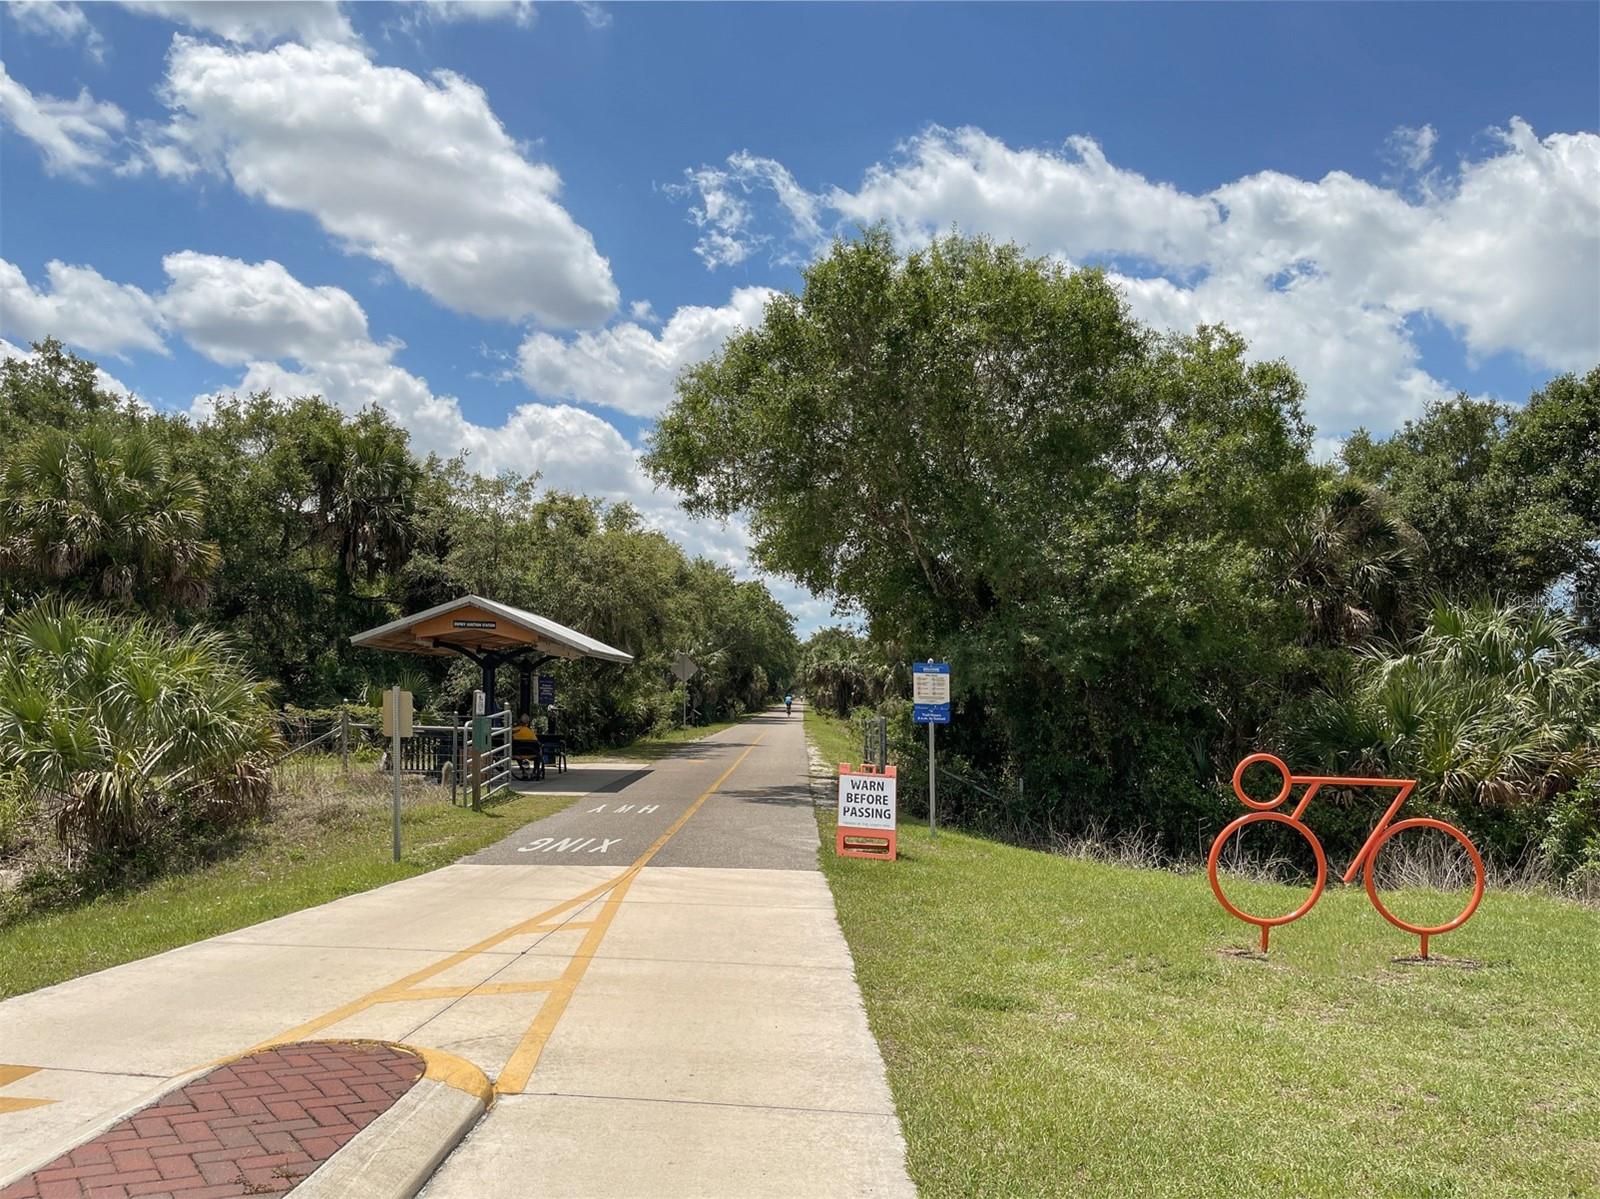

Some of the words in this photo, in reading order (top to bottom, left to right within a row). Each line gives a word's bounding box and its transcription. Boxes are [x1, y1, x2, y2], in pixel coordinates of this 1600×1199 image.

[850, 780, 885, 791] WARN
[846, 793, 889, 805] BEFORE
[843, 806, 891, 819] PASSING
[517, 837, 623, 853] XING
